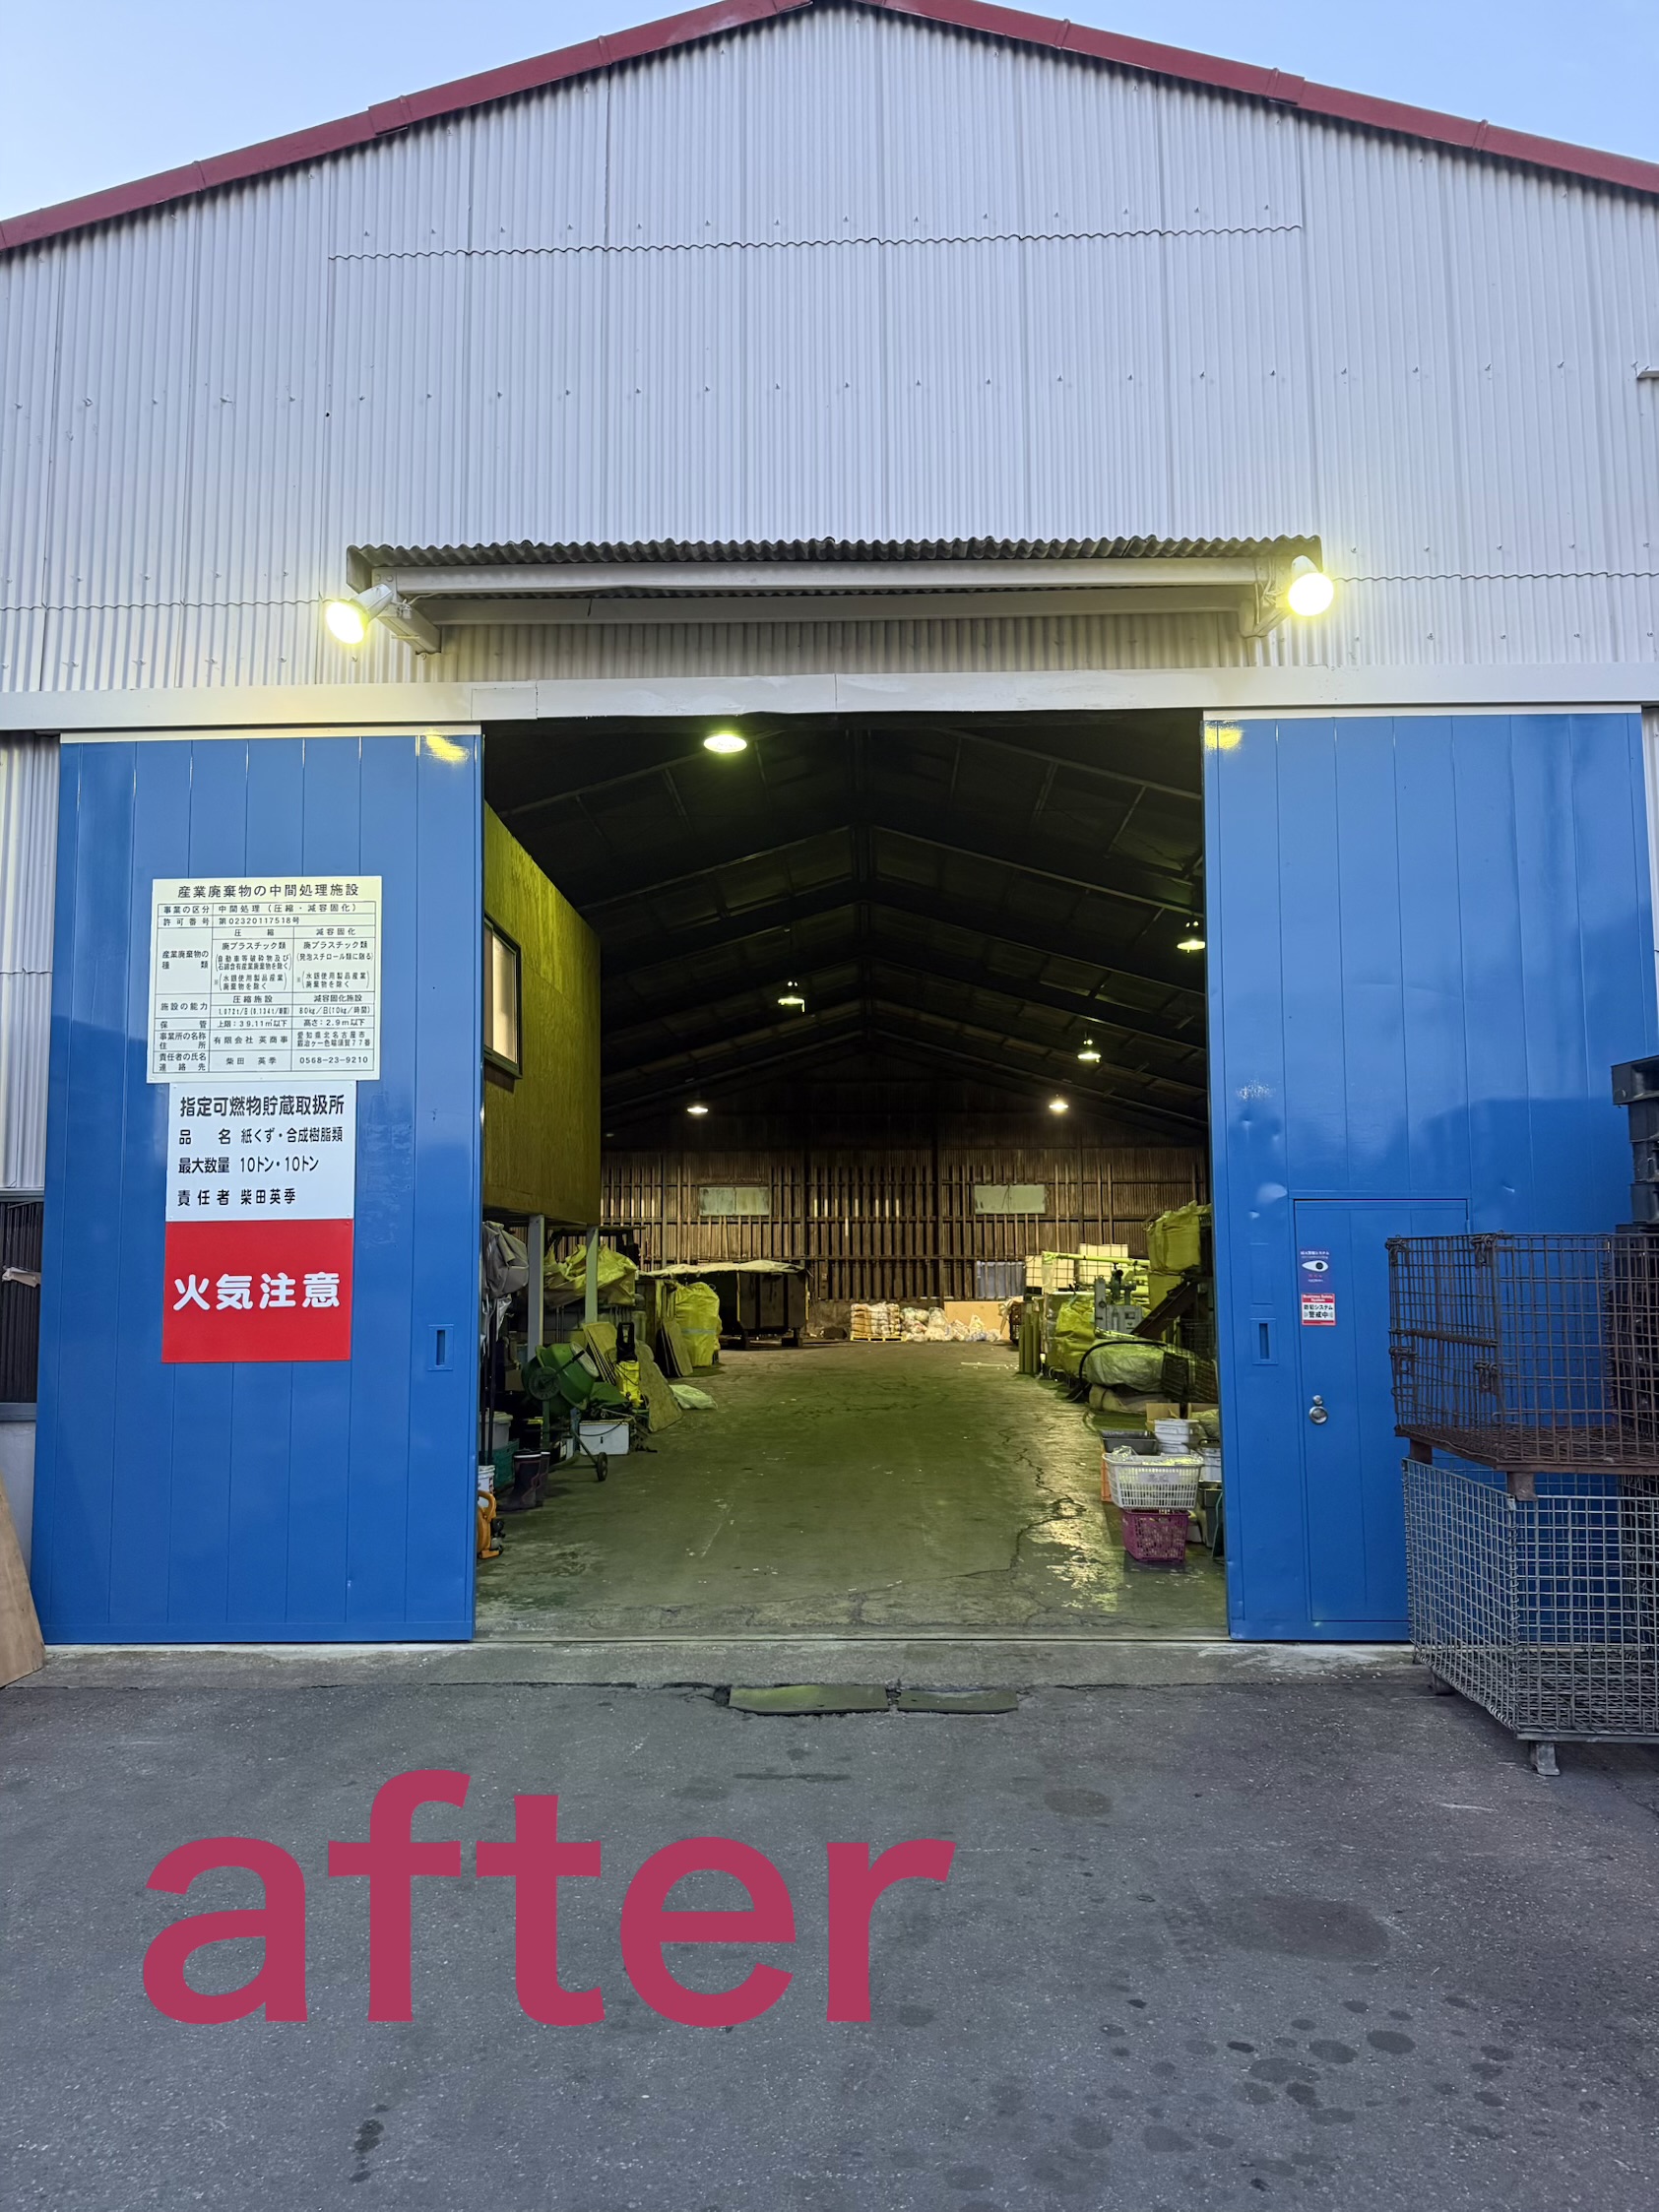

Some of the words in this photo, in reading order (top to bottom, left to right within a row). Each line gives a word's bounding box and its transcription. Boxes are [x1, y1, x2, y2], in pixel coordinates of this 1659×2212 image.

[177, 883, 359, 899] 産業廃棄物の中間処理施設
[163, 906, 210, 915] 事業の区分
[163, 917, 210, 926] 許可番号
[179, 1094, 345, 1117] 指定可燃物貯蔵取扱所
[240, 1126, 344, 1144] 紙くず・合成樹脂類
[178, 1157, 230, 1174] 最大数量
[240, 1155, 319, 1172] 10トン・10トン
[177, 1188, 230, 1207] 責任者
[240, 1187, 296, 1206] 柴田英季
[172, 1271, 341, 1311] 火気注意
